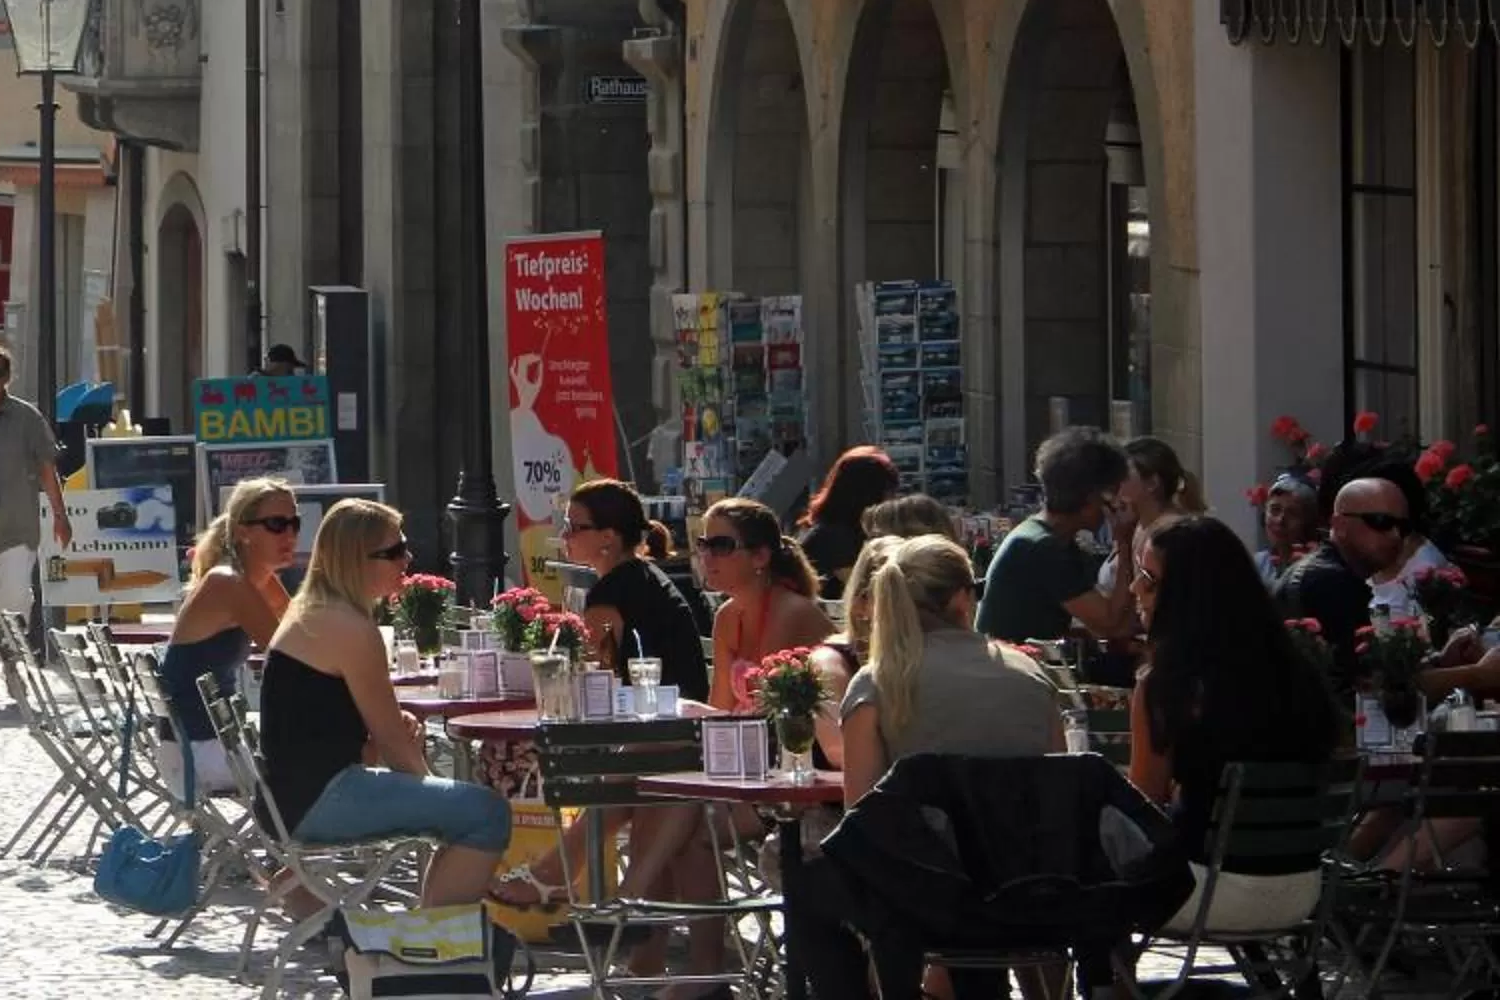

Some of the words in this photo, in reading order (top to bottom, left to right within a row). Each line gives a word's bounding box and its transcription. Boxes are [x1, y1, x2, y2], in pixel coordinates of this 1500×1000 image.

[515, 286, 584, 311] Wochen!
[201, 404, 325, 440] BAMBI
[523, 461, 561, 483] 70%
[71, 539, 169, 553] Lehmann
